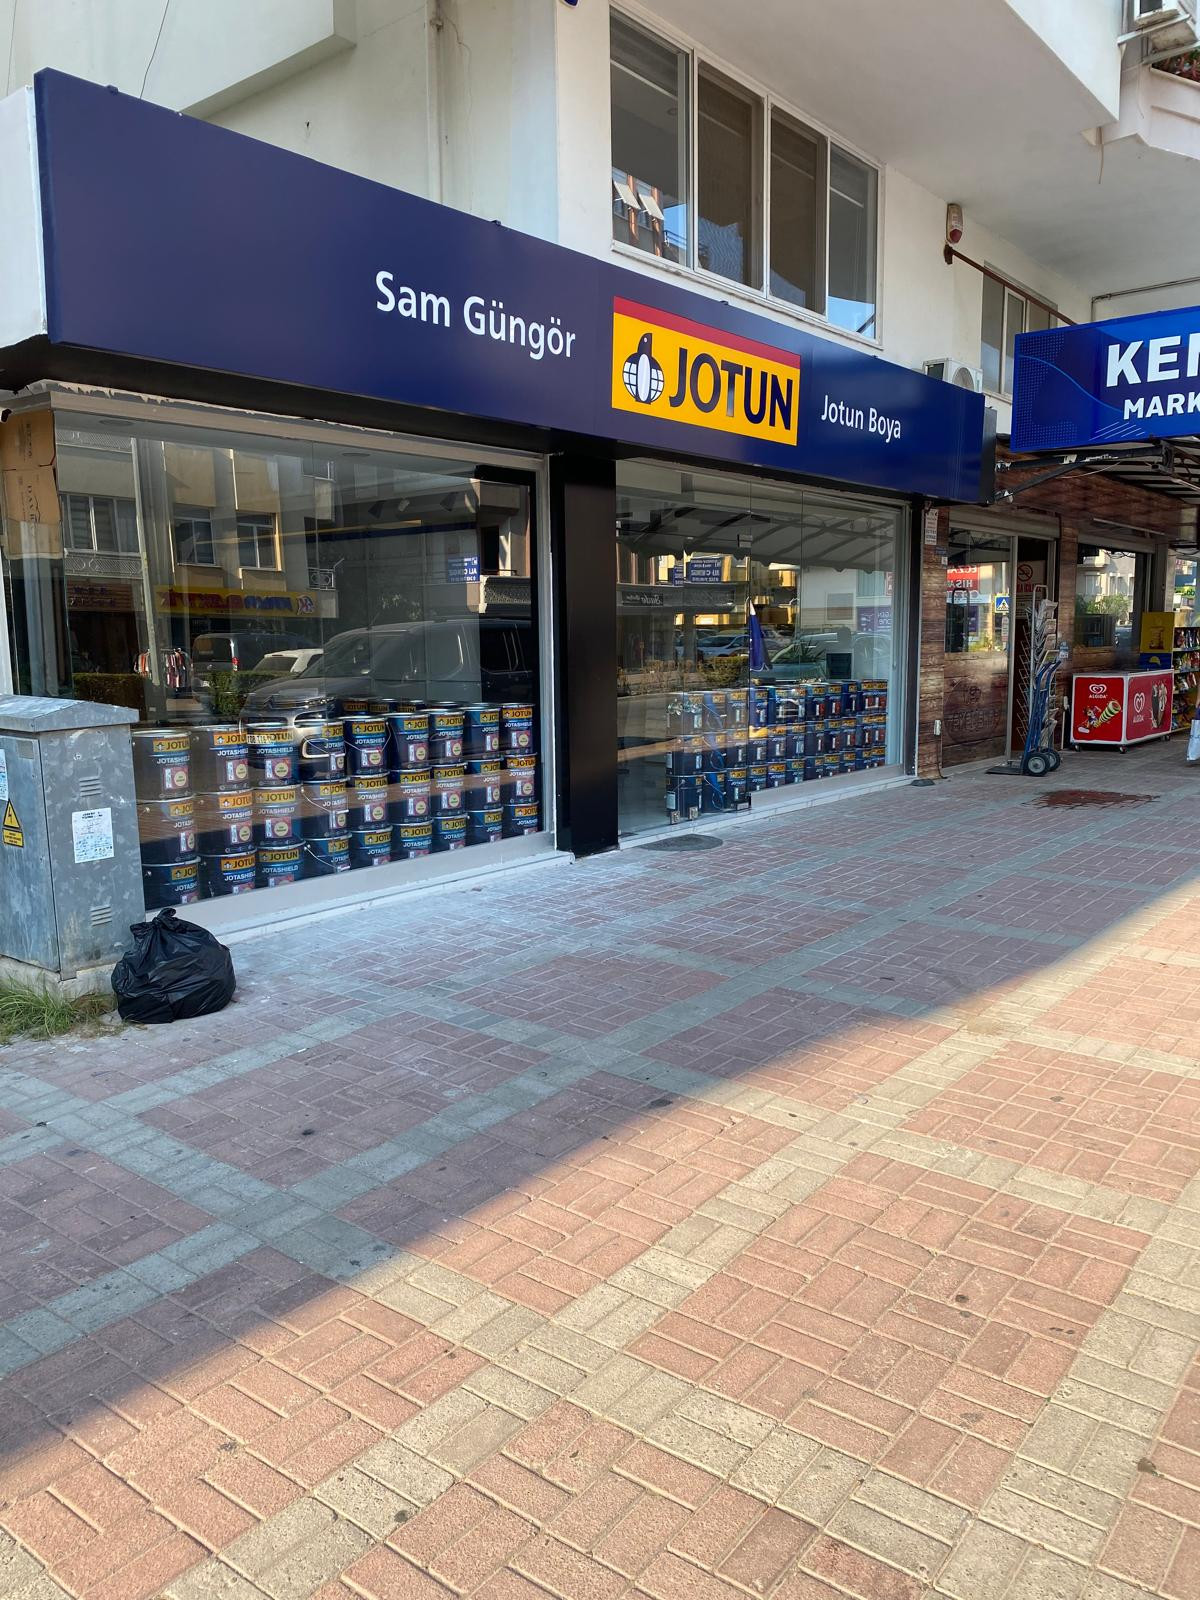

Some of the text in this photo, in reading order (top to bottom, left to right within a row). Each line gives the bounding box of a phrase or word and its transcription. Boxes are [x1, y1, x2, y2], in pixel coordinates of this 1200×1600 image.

[375, 270, 576, 360] Sam Güngör
[669, 347, 793, 430] JOTUN
[821, 394, 901, 443] Jotun Boya
[266, 792, 295, 801] JOTUN
[262, 865, 298, 873] JOTASHIELD
[270, 851, 298, 860] JOTUN
